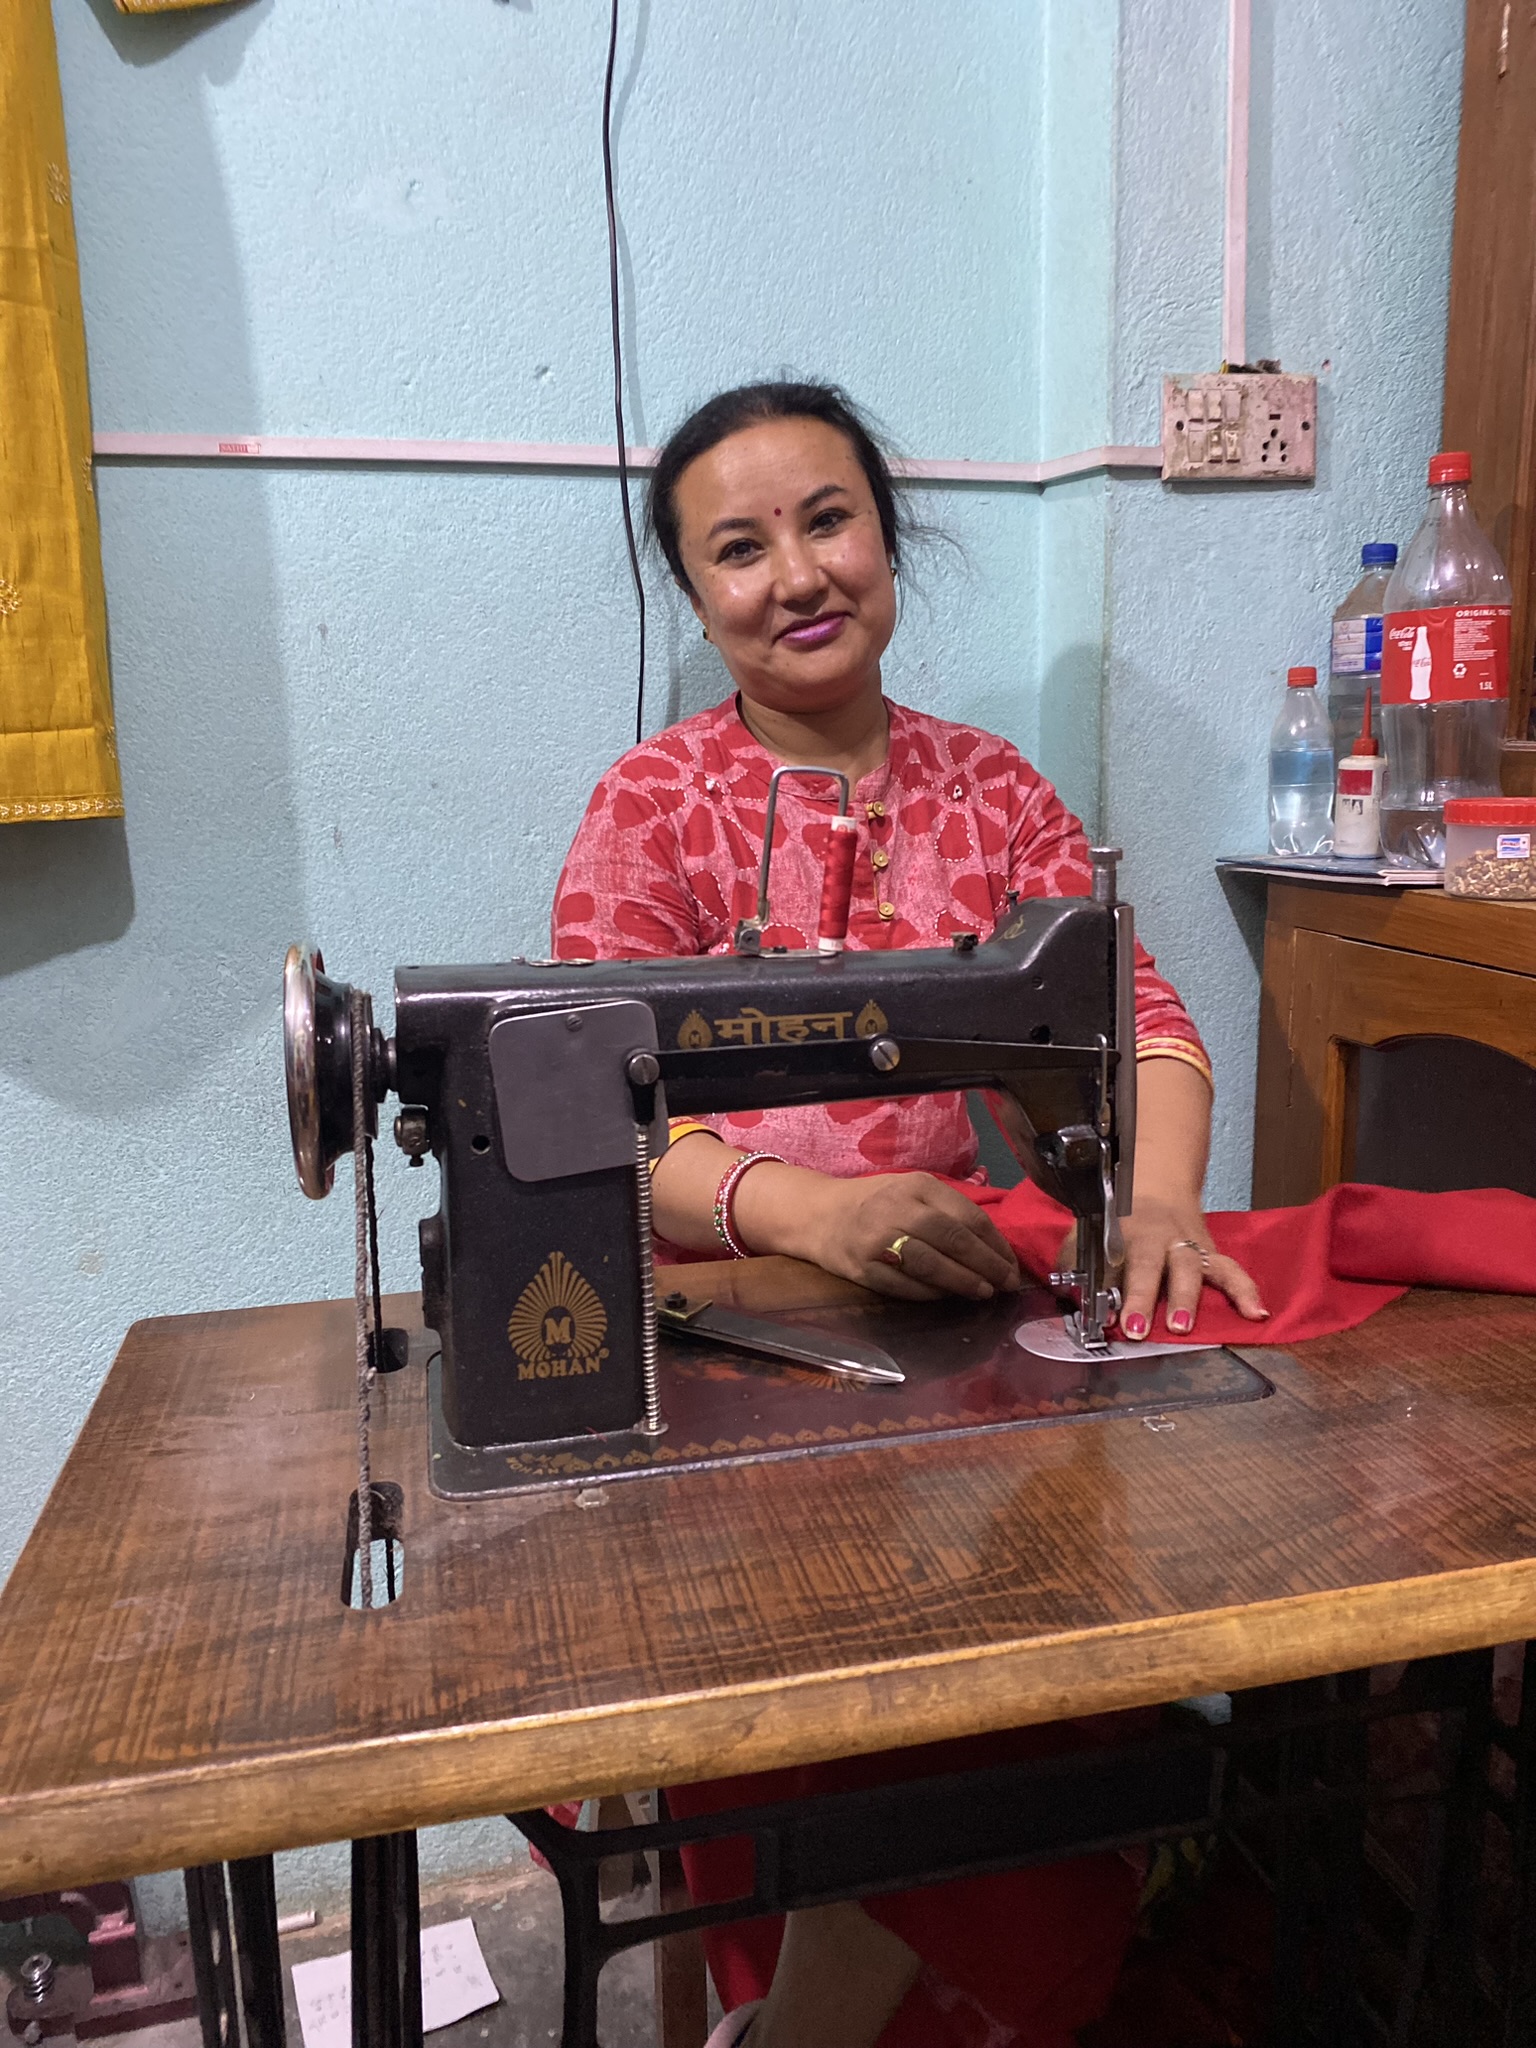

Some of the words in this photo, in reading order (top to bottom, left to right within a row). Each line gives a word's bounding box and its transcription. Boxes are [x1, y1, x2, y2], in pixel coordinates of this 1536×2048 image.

[1455, 609, 1497, 617] ORIGINAL
[714, 1007, 854, 1046] मोहन
[545, 1316, 572, 1345] M
[517, 1356, 601, 1380] MOHAN
